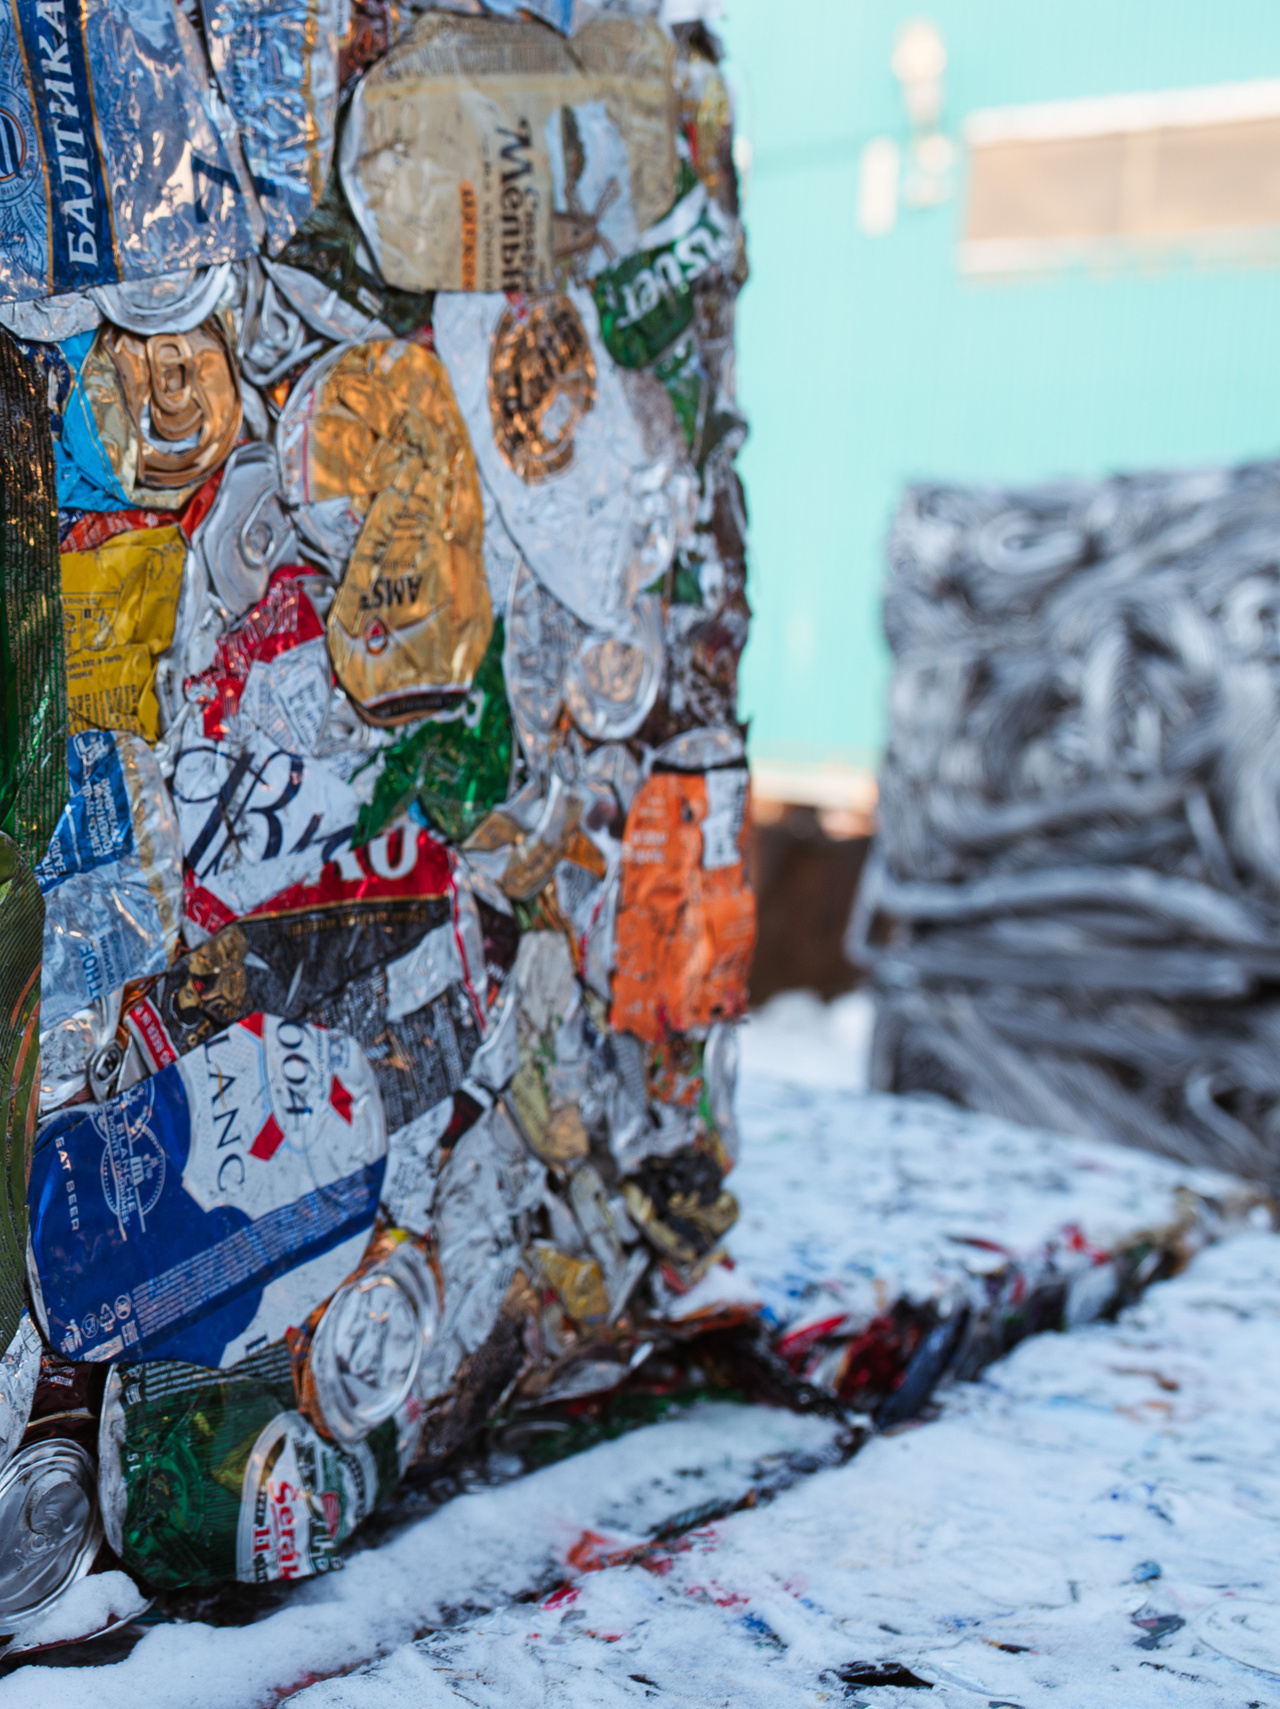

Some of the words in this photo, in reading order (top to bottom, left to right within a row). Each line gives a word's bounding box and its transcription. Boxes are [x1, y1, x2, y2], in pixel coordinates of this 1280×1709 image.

[35, 0, 99, 267] БАЛТИКА
[108, 1115, 119, 1156] POINTE
[204, 1032, 246, 1192] LANC
[66, 1180, 79, 1231] BEER
[117, 1123, 137, 1213] BLANCHE
